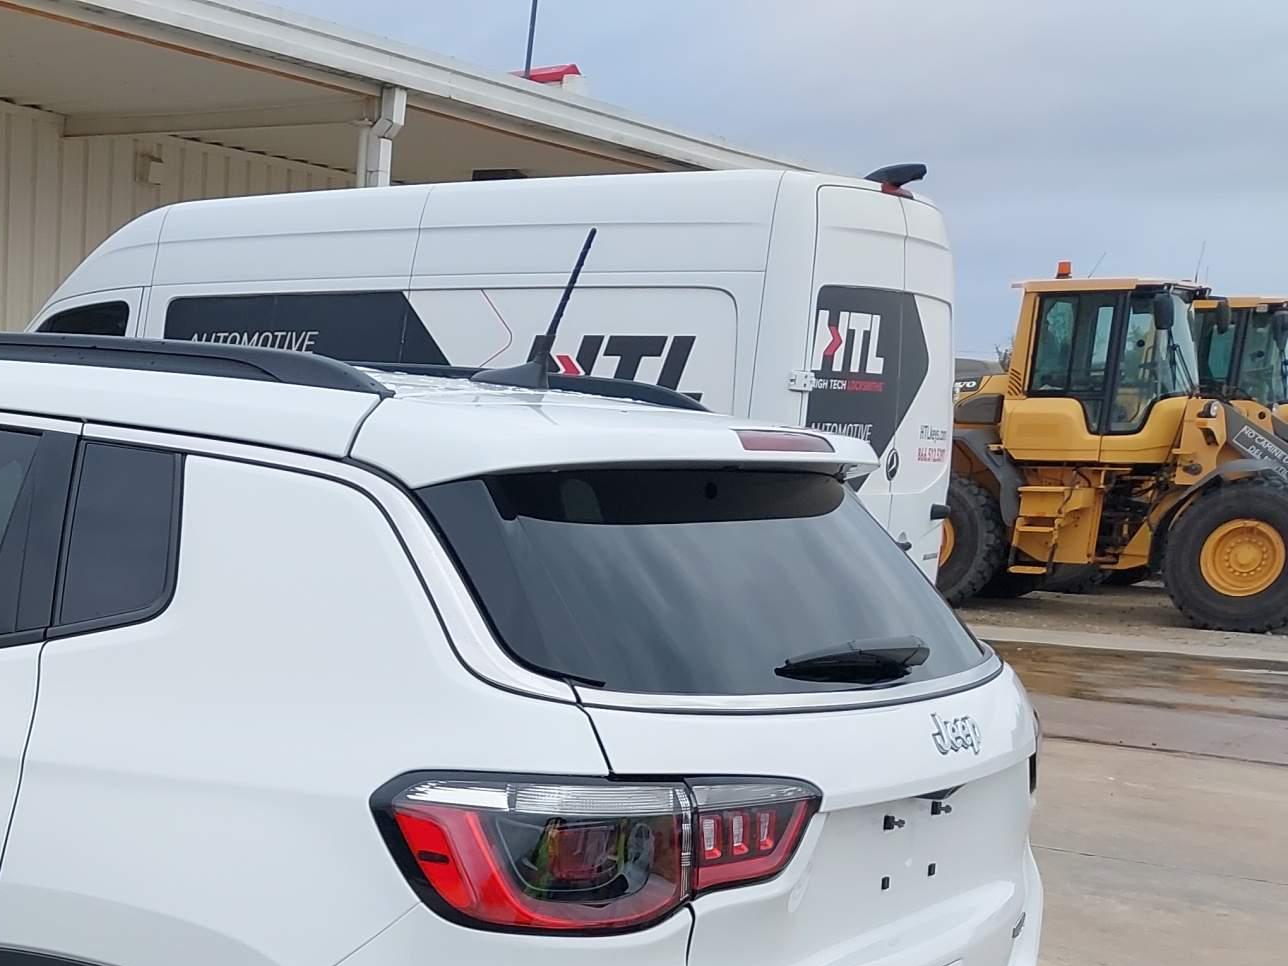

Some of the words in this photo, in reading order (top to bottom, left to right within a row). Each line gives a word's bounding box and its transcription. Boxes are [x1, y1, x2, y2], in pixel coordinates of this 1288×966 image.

[811, 310, 884, 374] HTL
[830, 379, 847, 390] TECH
[931, 712, 981, 755] Jeep
